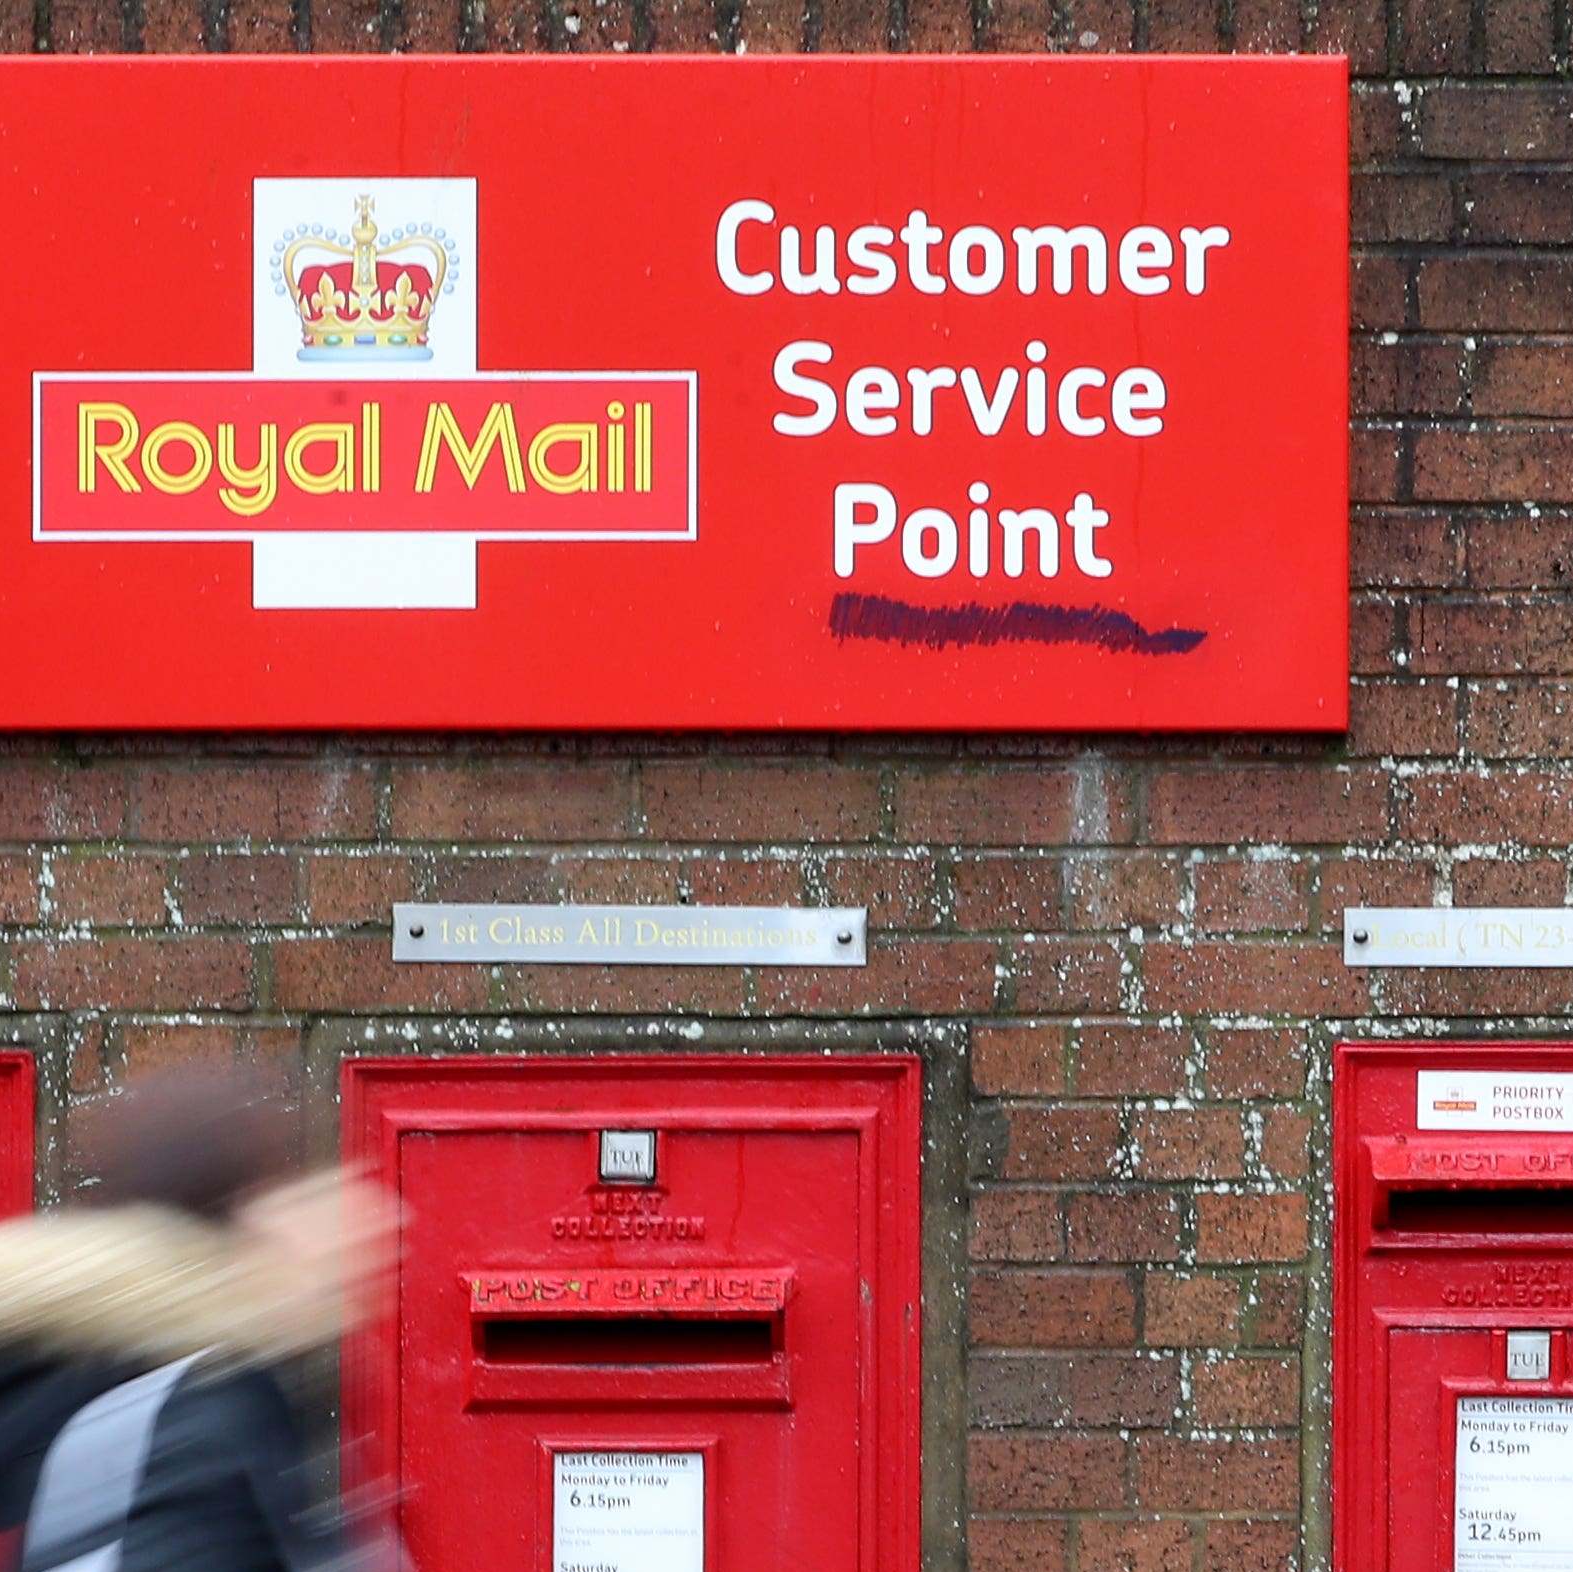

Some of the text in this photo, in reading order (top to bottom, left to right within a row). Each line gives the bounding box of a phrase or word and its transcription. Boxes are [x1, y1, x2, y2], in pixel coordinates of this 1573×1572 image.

[715, 198, 1231, 296] Customer
[772, 339, 1167, 437] Service
[78, 400, 652, 517] Royal Mail
[833, 480, 1113, 578] Point
[440, 916, 818, 948] 1st Class All Destinations
[1372, 922, 1447, 950] Local
[1493, 1086, 1564, 1100] PRIORITY
[1493, 1106, 1564, 1120] POSTBOX
[1408, 1152, 1504, 1173] POST
[551, 1216, 705, 1240] COLLECTION
[478, 1276, 777, 1301] POST OFFICE
[1461, 1400, 1488, 1413] Last
[1492, 1400, 1553, 1414] Collection
[1461, 1419, 1569, 1434] Monday to Friday
[1470, 1435, 1530, 1455] 6.15pm
[561, 1454, 689, 1468] Last Collection Time
[561, 1473, 669, 1488] Monday to Friday
[570, 1489, 631, 1510] 6.15pm
[1459, 1508, 1516, 1522] Saturday
[1468, 1523, 1542, 1543] 12.45pm
